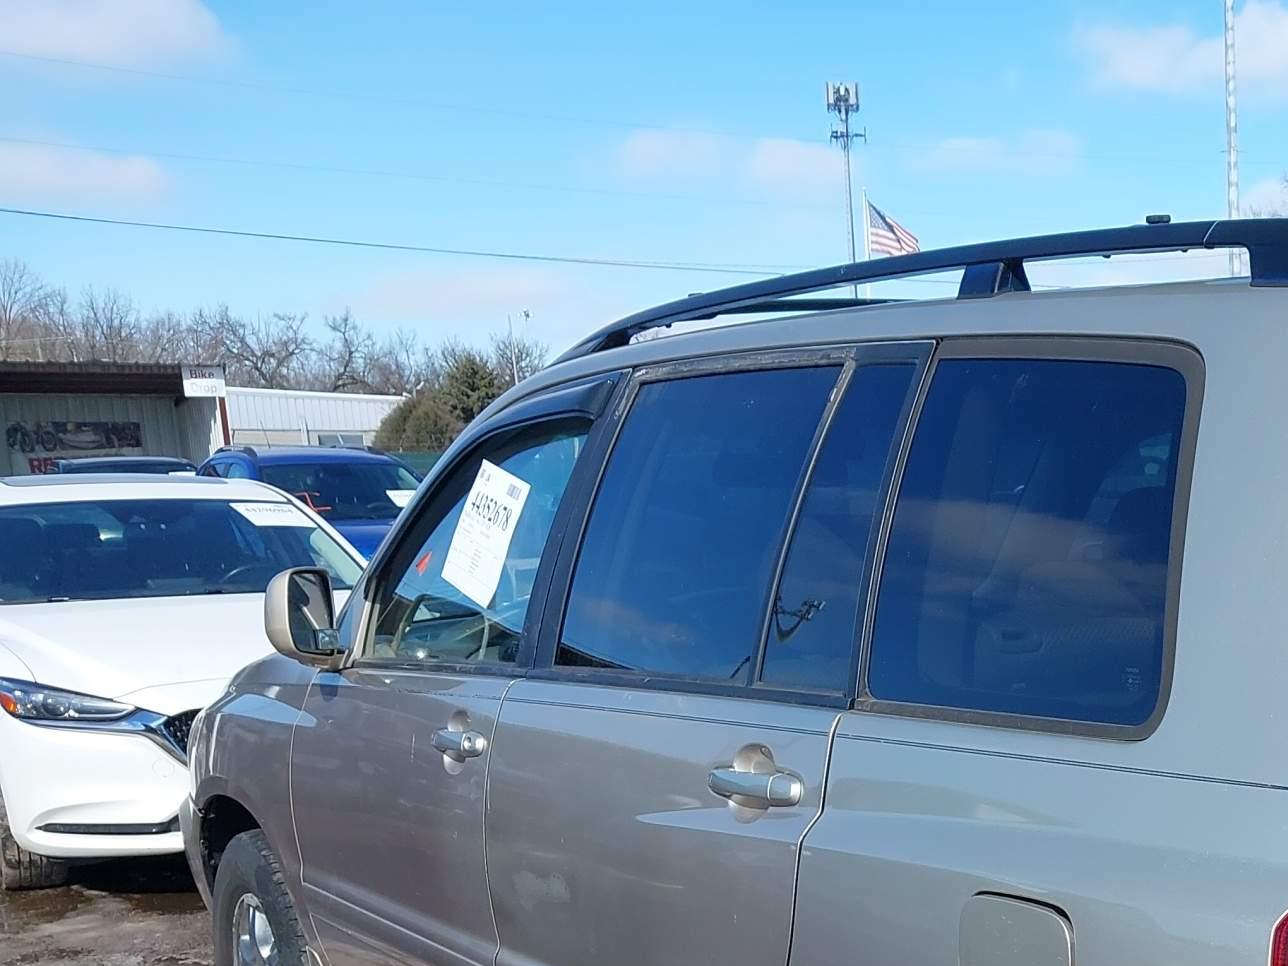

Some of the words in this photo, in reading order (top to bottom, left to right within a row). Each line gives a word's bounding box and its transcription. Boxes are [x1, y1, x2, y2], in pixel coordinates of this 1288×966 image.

[190, 369, 214, 378] Bike
[190, 382, 217, 393] Drop
[471, 490, 512, 531] 44352678
